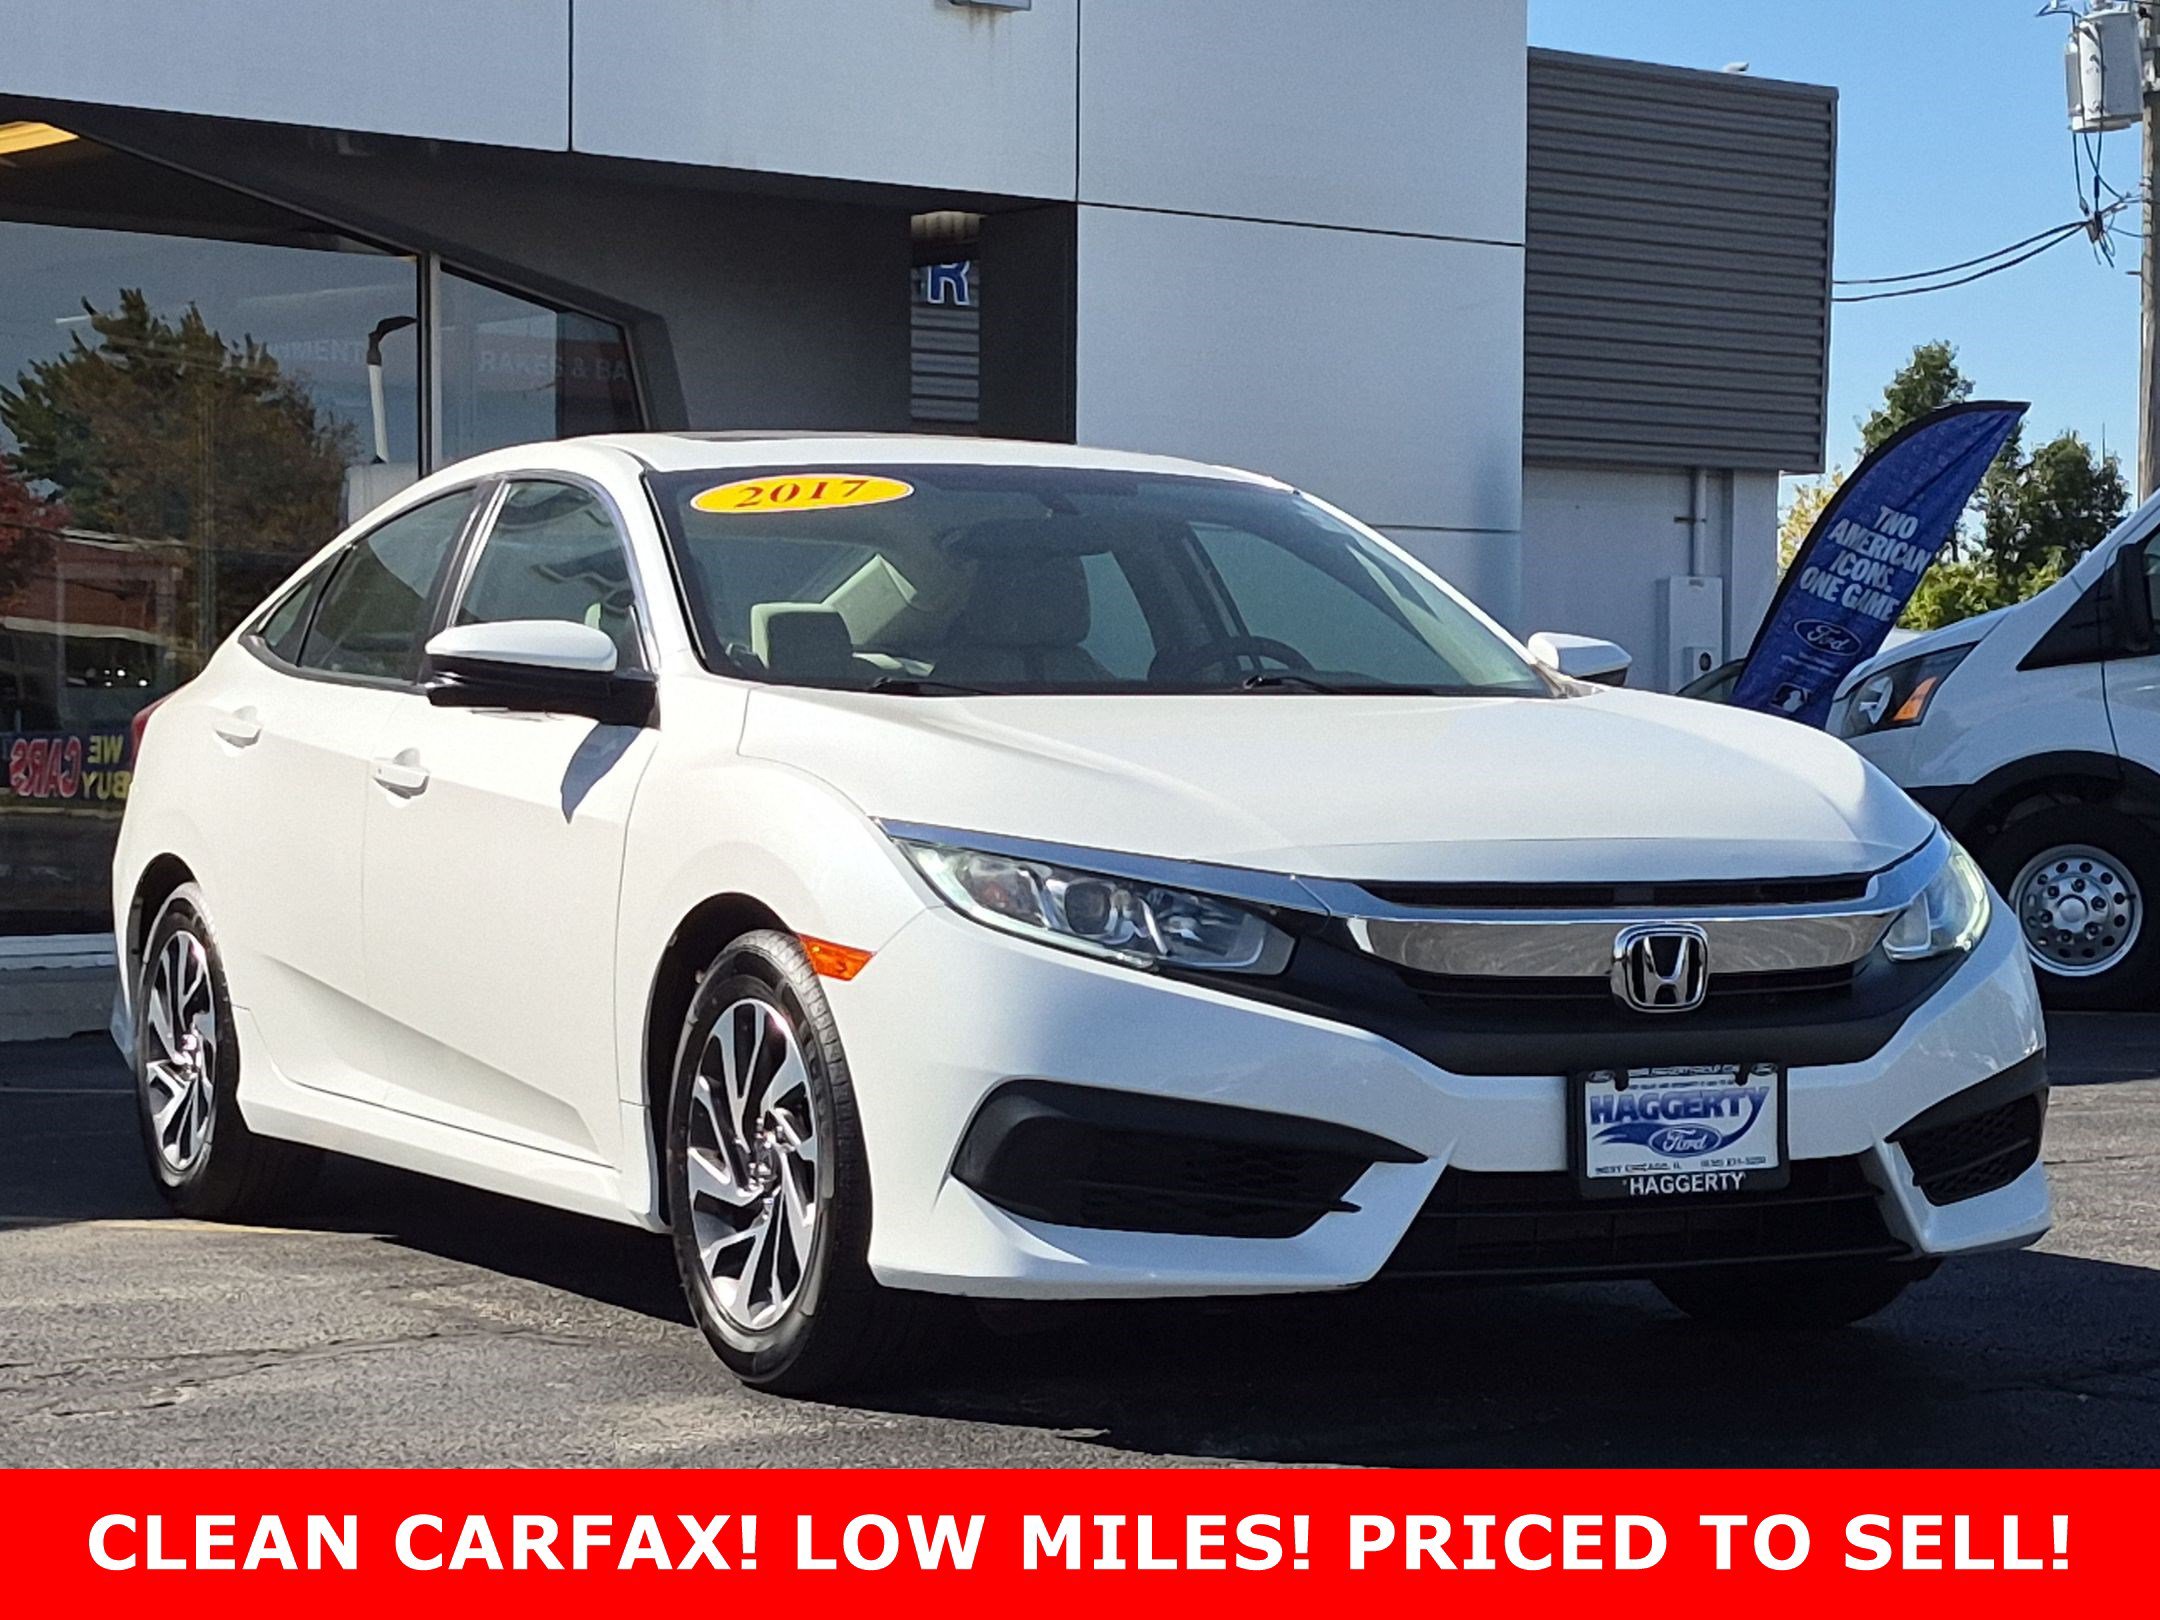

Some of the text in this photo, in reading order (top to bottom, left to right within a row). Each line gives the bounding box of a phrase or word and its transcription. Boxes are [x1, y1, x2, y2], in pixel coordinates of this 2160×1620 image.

[734, 479, 870, 508] 2017
[1827, 517, 1932, 576] AMERICAN
[1799, 566, 1846, 601] ONE
[1590, 1086, 1770, 1125] HAGGERTY
[1662, 1128, 1709, 1153] Ford
[1629, 1172, 1744, 1196] HAGGERTY
